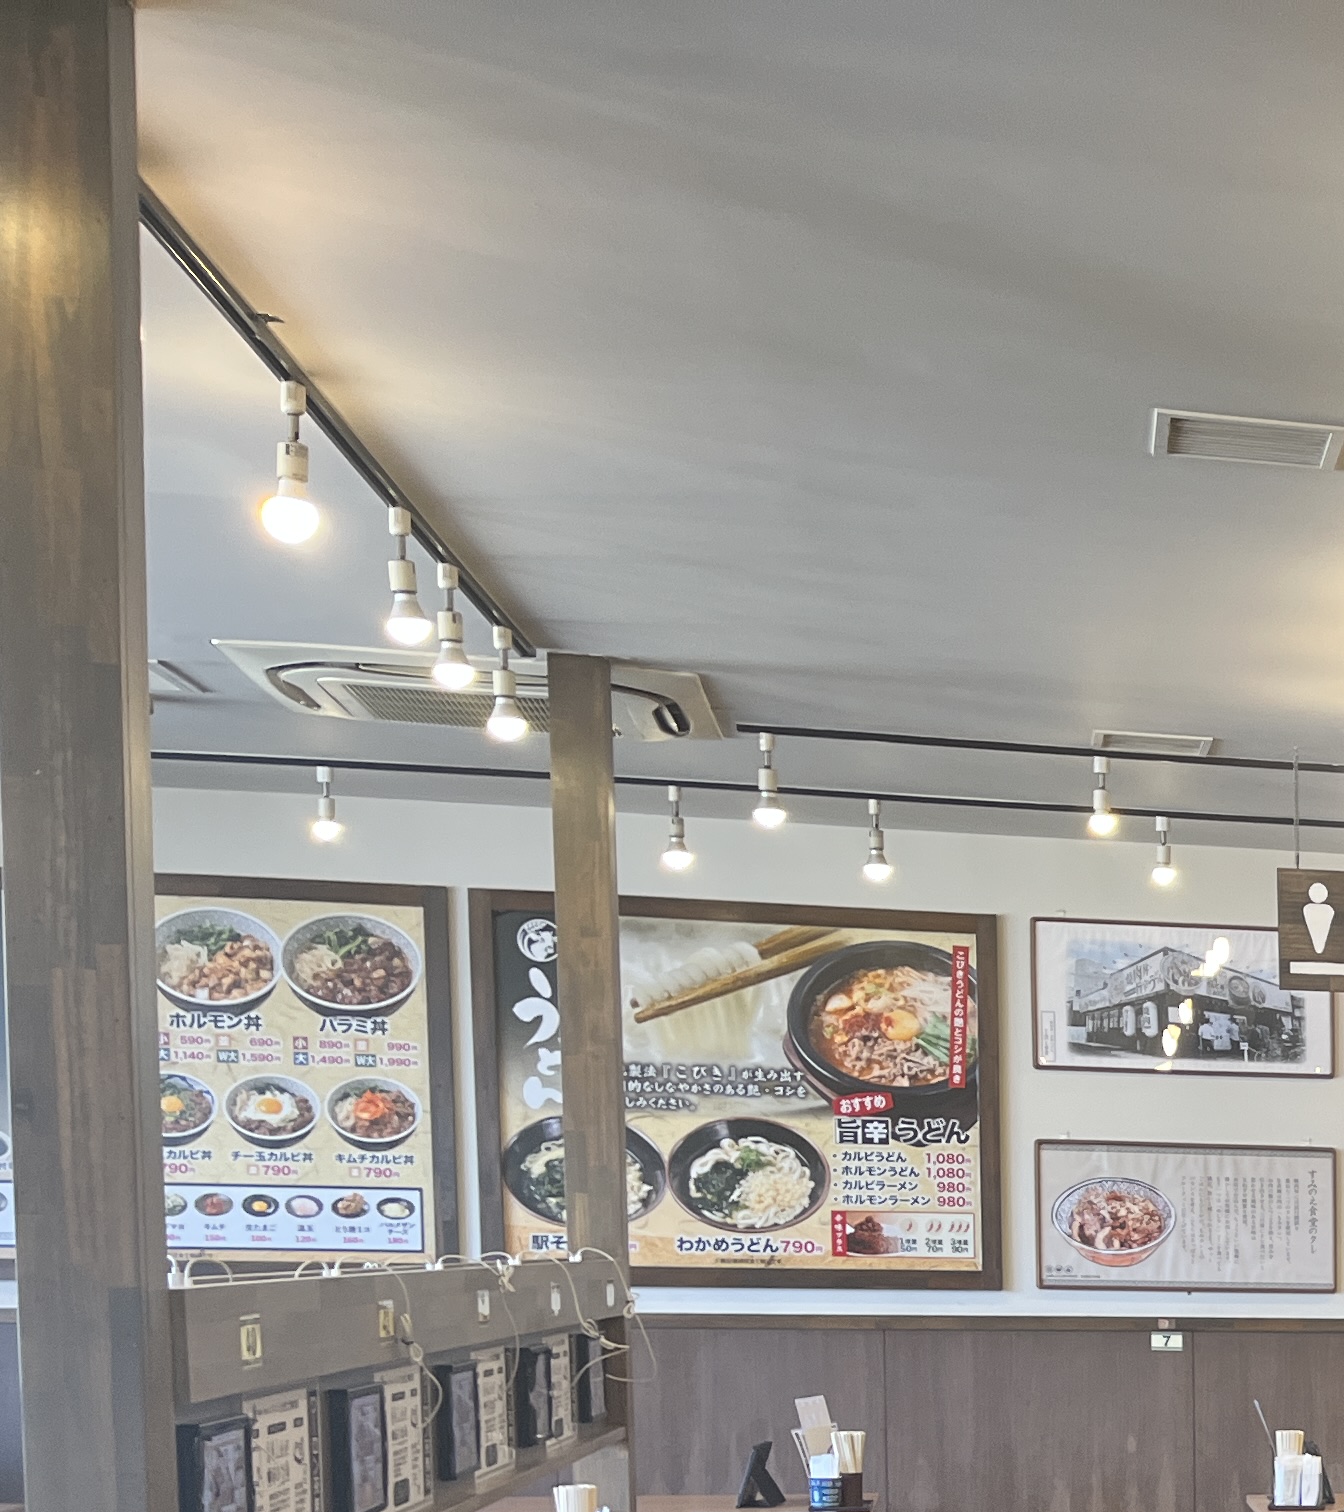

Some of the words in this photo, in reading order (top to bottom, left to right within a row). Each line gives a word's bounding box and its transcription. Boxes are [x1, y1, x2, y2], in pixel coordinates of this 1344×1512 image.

[169, 1012, 262, 1031] ホルモン丼
[319, 1018, 388, 1036] ハラミ丼
[294, 1053, 308, 1065] 大
[623, 1063, 805, 1083] 製法『こびき』が生み出す
[839, 1094, 887, 1114] おすすめ
[836, 1117, 970, 1145] 旨辛うどん
[165, 1150, 212, 1162] カルビ丼
[231, 1150, 314, 1163] チー玉カルビ丼
[335, 1153, 415, 1166] キムチカルビ丼
[841, 1151, 907, 1163] カルビうどん
[841, 1165, 920, 1178] ホルモンうどん
[842, 1180, 918, 1191] カルビラーメン
[842, 1194, 931, 1206] ホルモンラーメン
[676, 1236, 779, 1253] わかめうどん
[780, 1240, 823, 1254] 790円
[1163, 1335, 1171, 1346] 7
